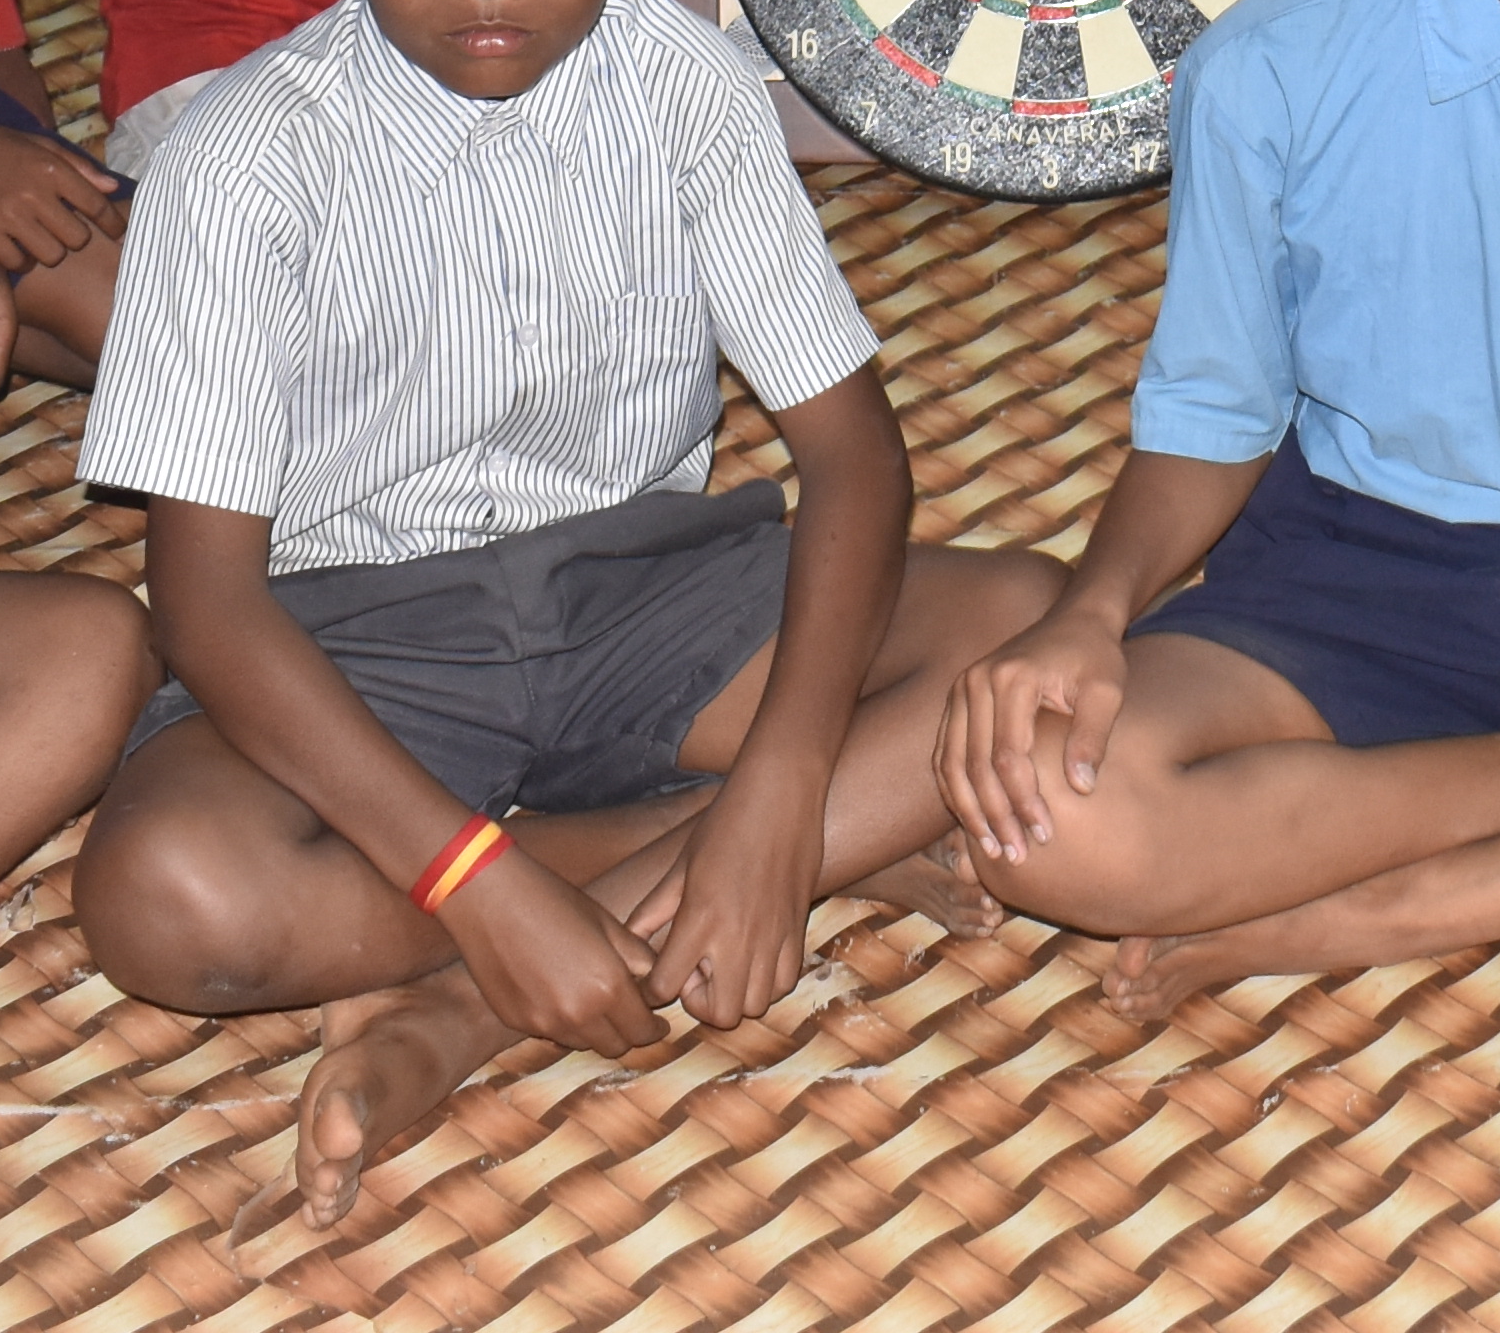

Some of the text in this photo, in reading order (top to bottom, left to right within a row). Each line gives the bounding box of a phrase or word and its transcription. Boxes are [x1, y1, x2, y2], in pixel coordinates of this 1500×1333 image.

[789, 28, 818, 60] 16
[861, 101, 878, 131] 7
[969, 116, 1131, 146] CANAVERAL
[939, 142, 972, 176] 19
[1041, 156, 1059, 190] 3
[1129, 141, 1161, 173] 17
